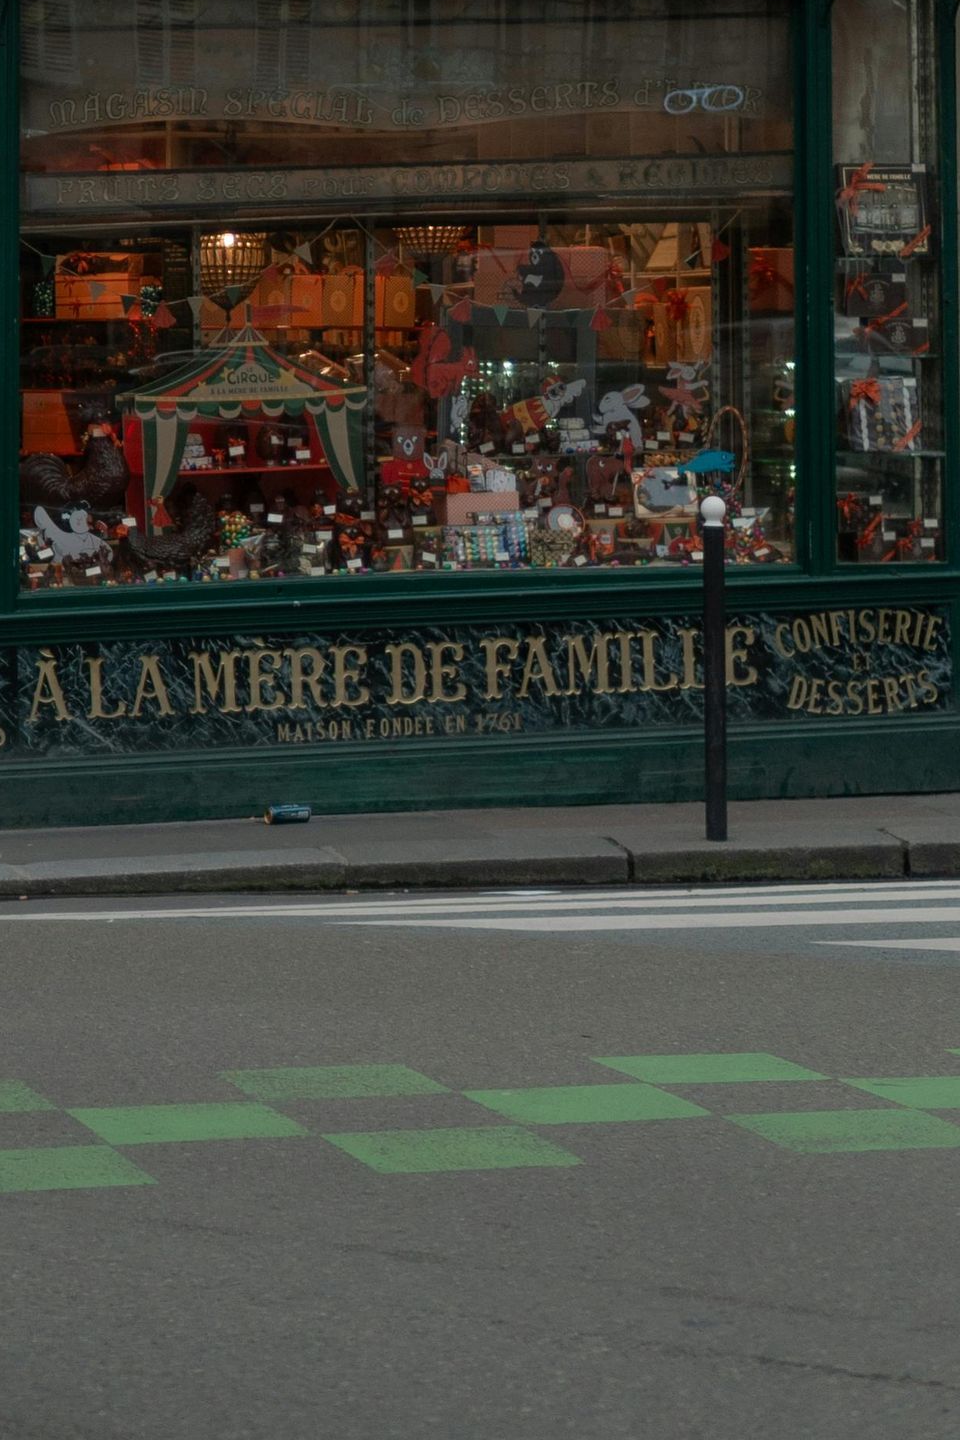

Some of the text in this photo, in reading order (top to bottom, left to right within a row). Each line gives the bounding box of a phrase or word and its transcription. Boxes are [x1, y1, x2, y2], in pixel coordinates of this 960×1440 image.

[48, 86, 208, 129] MAGASIN
[436, 80, 620, 125] DESSERTS
[54, 175, 181, 206] FRUITS
[195, 173, 289, 201] SECS
[774, 608, 944, 659] CONFISERIE
[29, 626, 760, 722] À LA MÈRE DE FAMILLE
[851, 653, 873, 673] ET
[786, 670, 940, 716] DESSERTS
[277, 720, 352, 743] MAISON
[445, 713, 467, 734] EN
